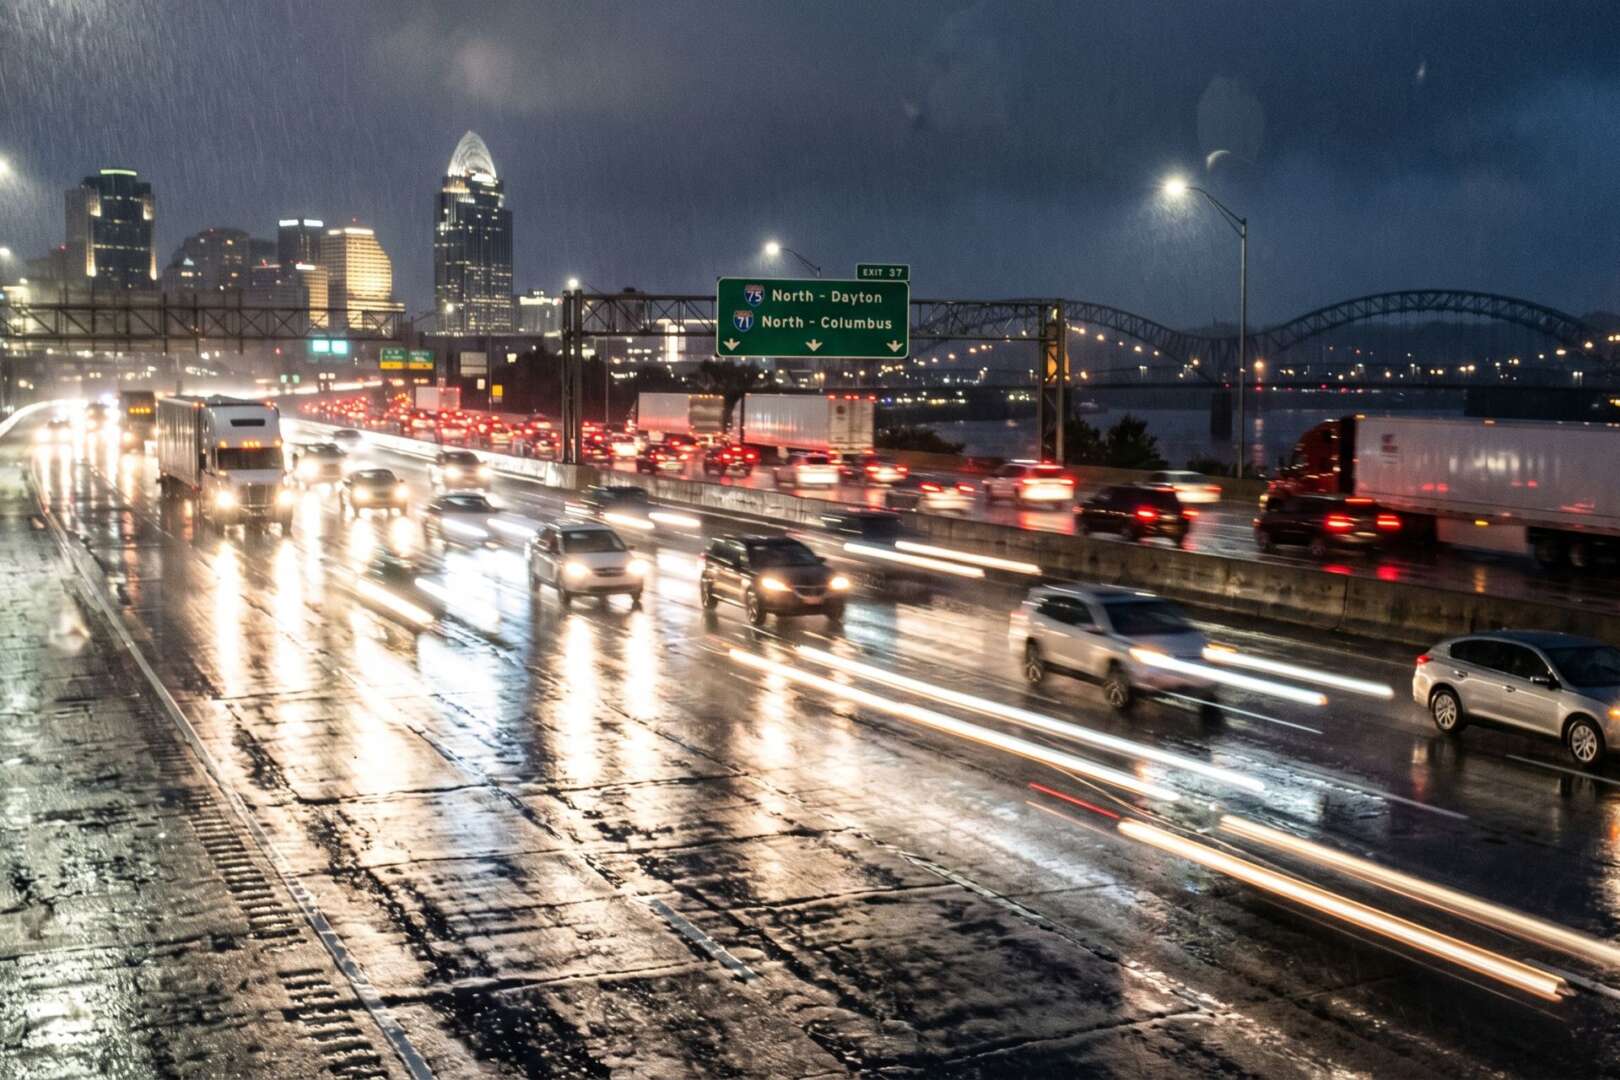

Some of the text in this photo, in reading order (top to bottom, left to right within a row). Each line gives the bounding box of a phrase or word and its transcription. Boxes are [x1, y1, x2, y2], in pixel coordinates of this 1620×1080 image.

[862, 268, 903, 278] EXIT 37
[746, 290, 762, 303] 75
[772, 289, 814, 302] North
[831, 290, 883, 306] Dayton
[737, 316, 750, 329] 71
[762, 315, 804, 328] North
[820, 316, 892, 329] Columbus
